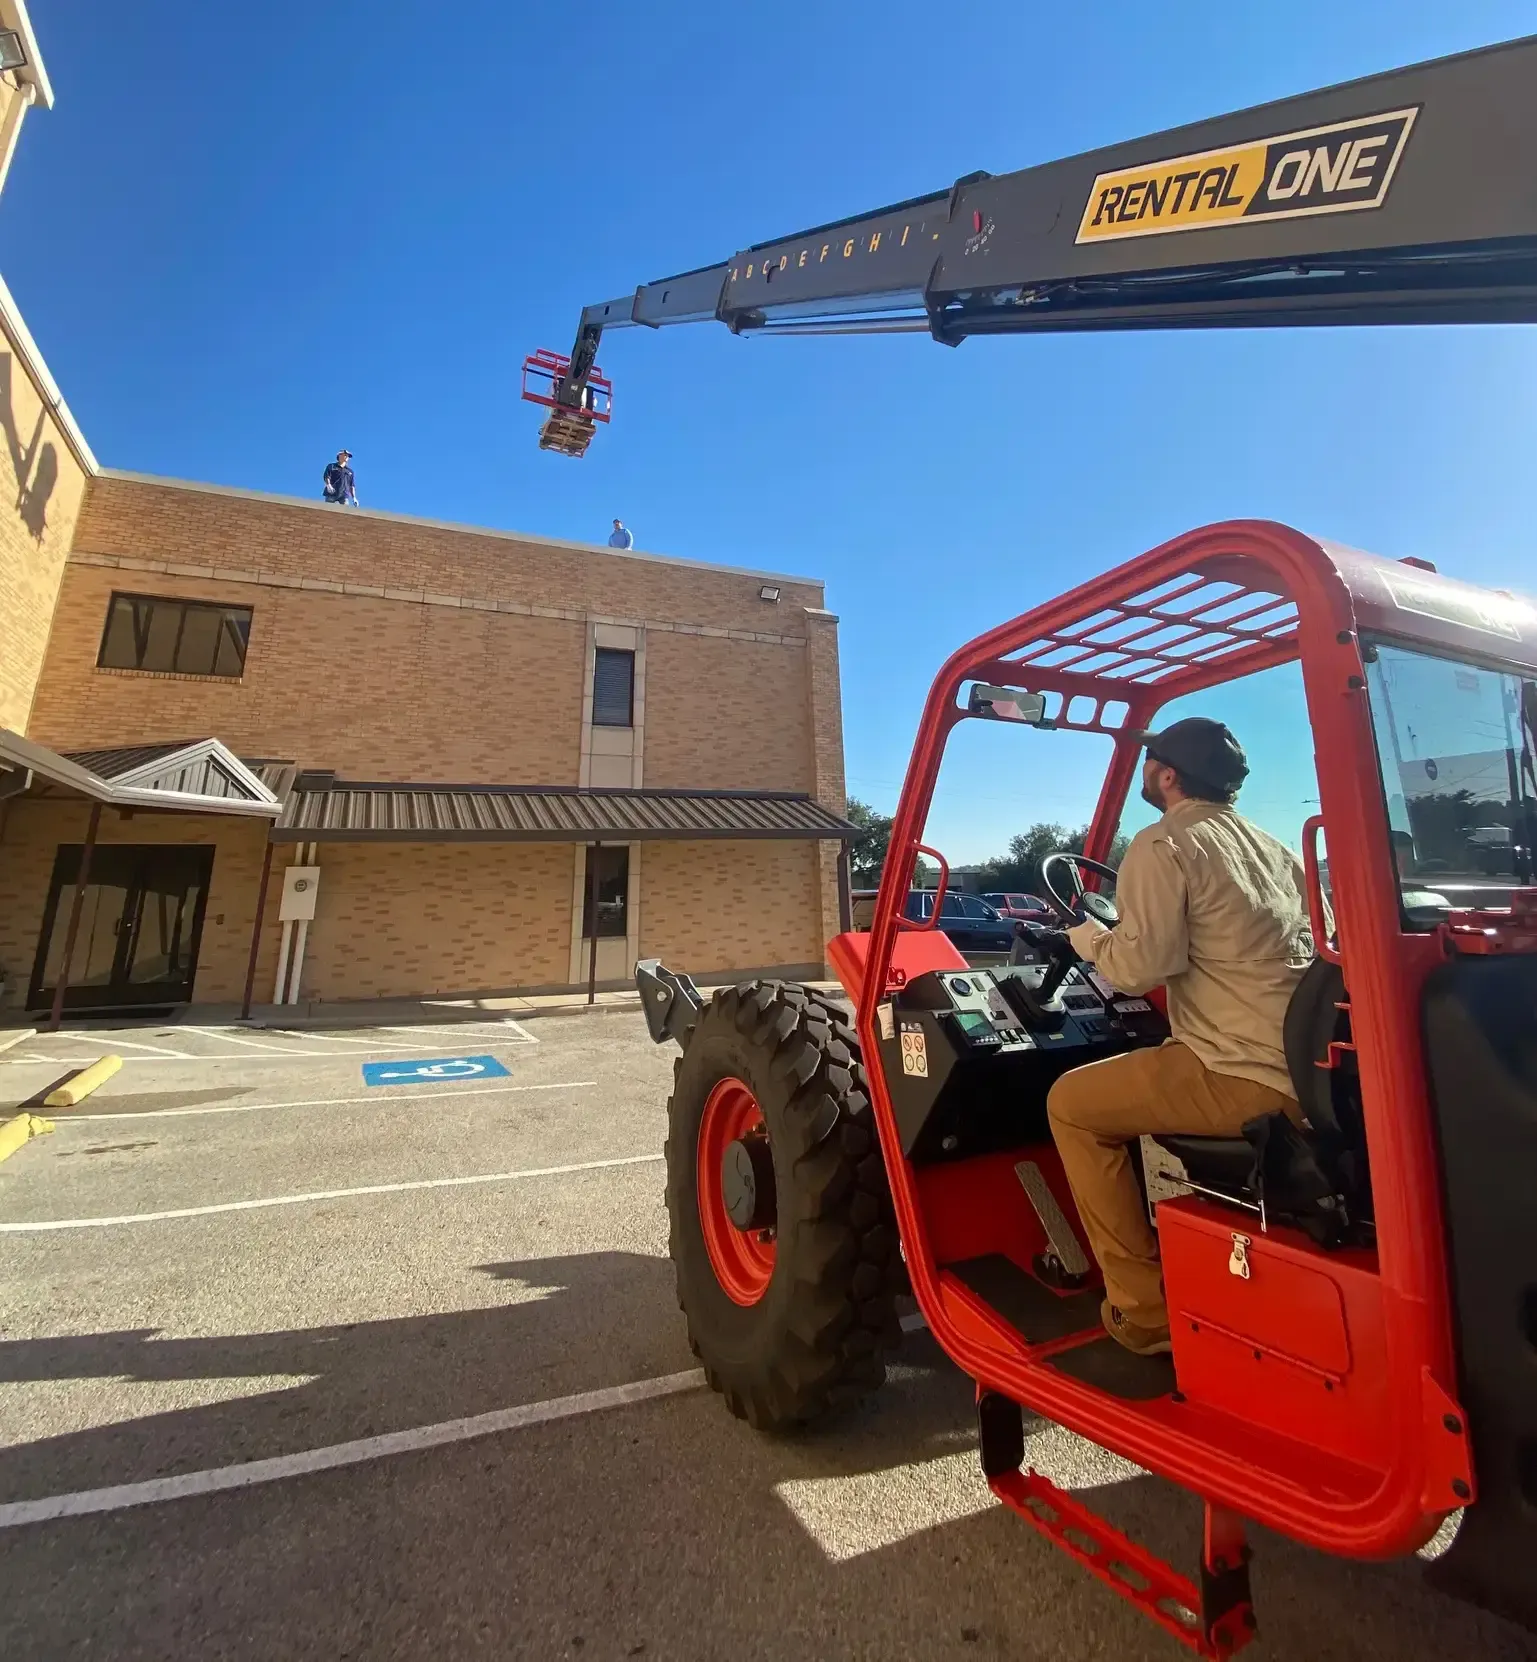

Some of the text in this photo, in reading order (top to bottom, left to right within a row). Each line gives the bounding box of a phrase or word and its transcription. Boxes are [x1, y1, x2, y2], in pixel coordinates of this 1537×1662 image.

[1091, 134, 1389, 226] RENTAL ONE
[731, 225, 909, 282] A B C D E F G H I
